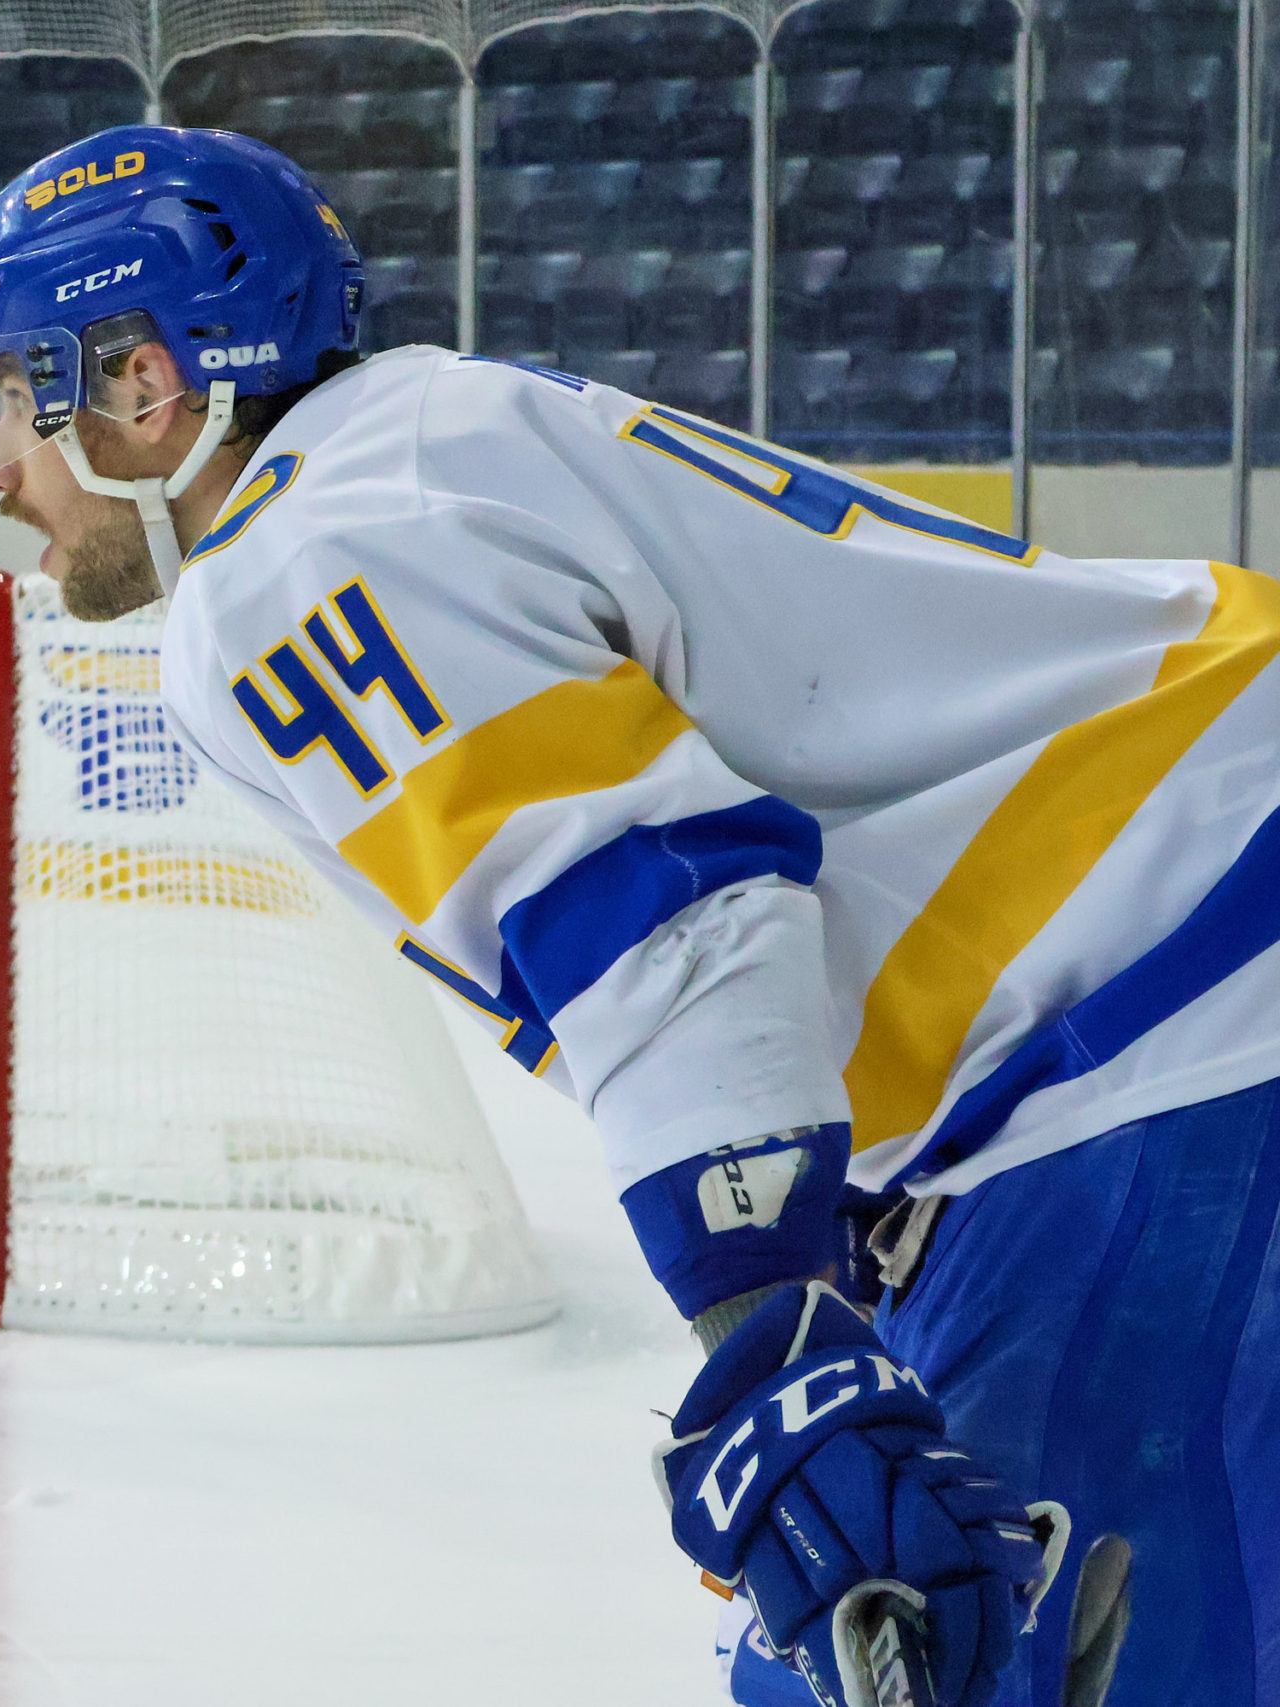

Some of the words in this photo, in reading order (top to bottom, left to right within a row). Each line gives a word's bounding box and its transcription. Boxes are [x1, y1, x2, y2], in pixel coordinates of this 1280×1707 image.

[24, 150, 146, 211] BOLD
[55, 258, 144, 303] CCM
[199, 341, 280, 370] OUA
[34, 414, 73, 427] CCM
[230, 574, 451, 801] 44
[695, 1354, 929, 1532] CCM
